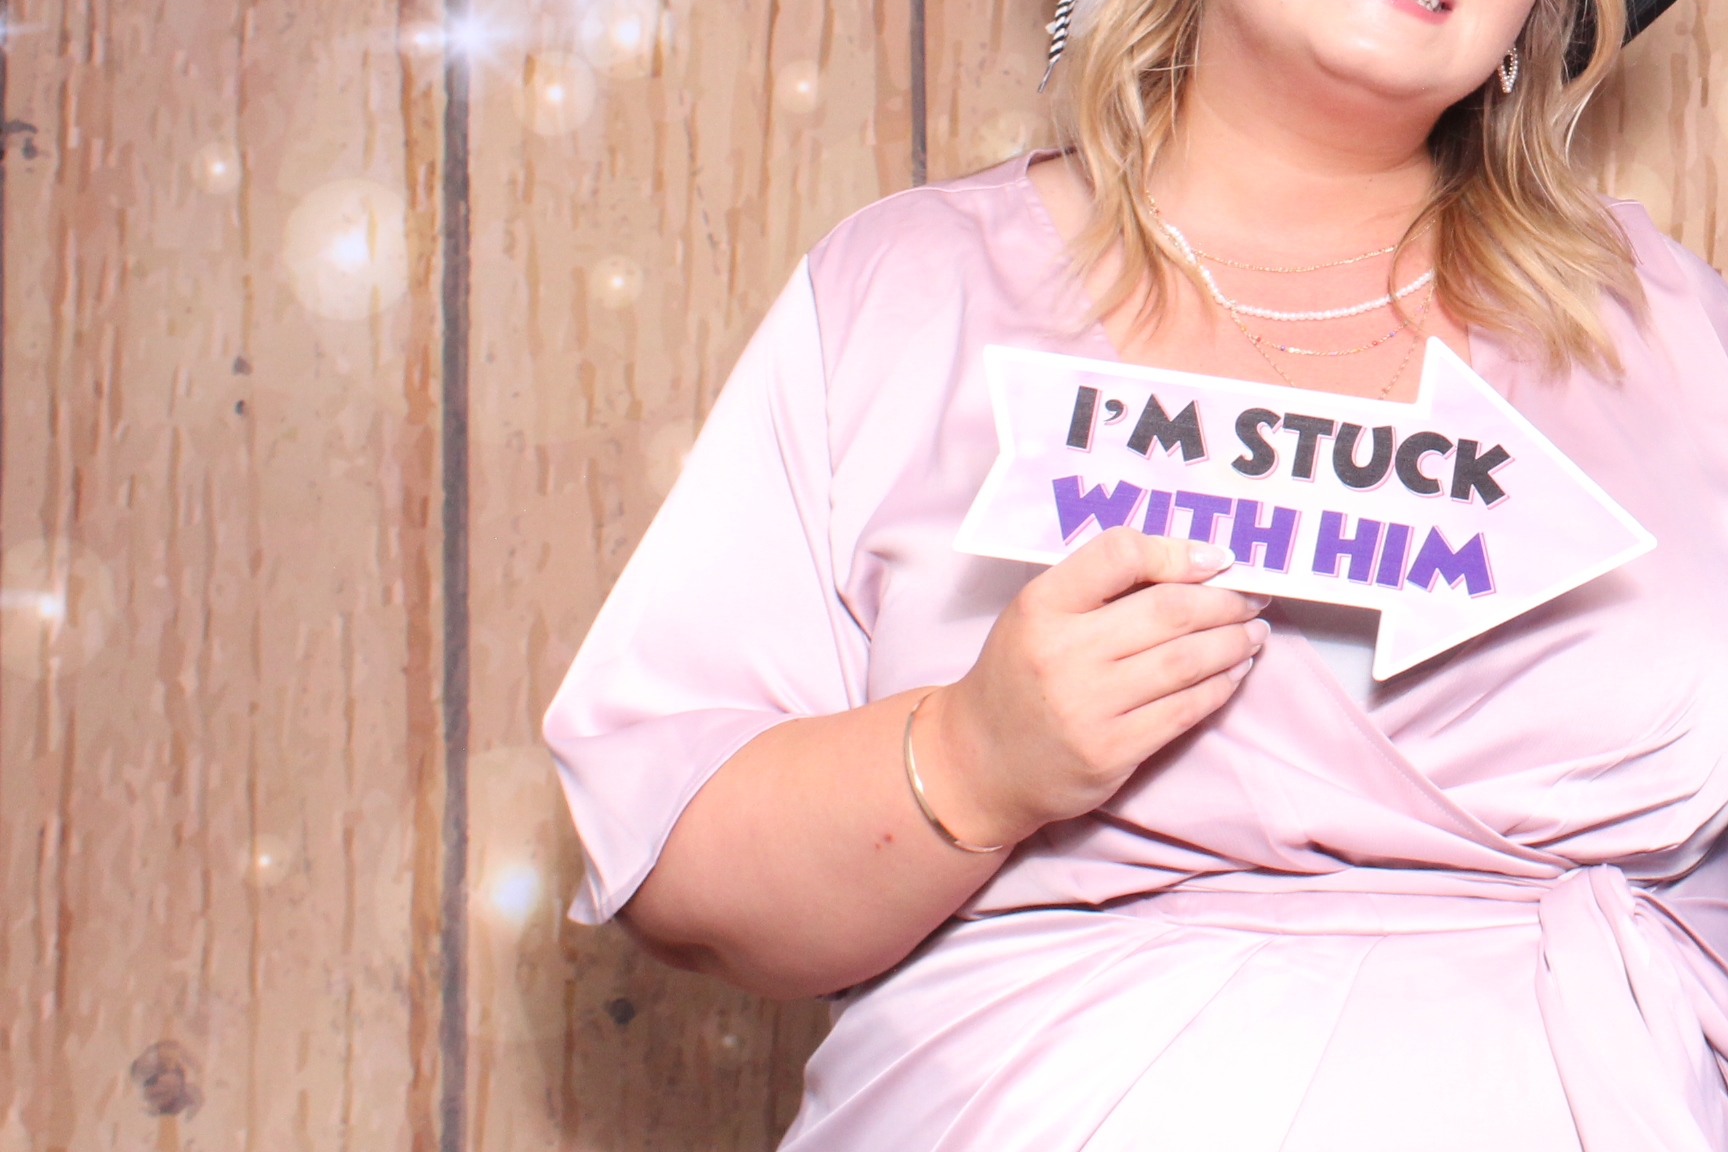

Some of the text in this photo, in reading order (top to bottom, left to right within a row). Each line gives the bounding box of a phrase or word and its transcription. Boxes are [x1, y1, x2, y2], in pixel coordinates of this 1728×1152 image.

[1066, 385, 1514, 508] I'M STUCK
[1052, 475, 1497, 597] WITH HIM
